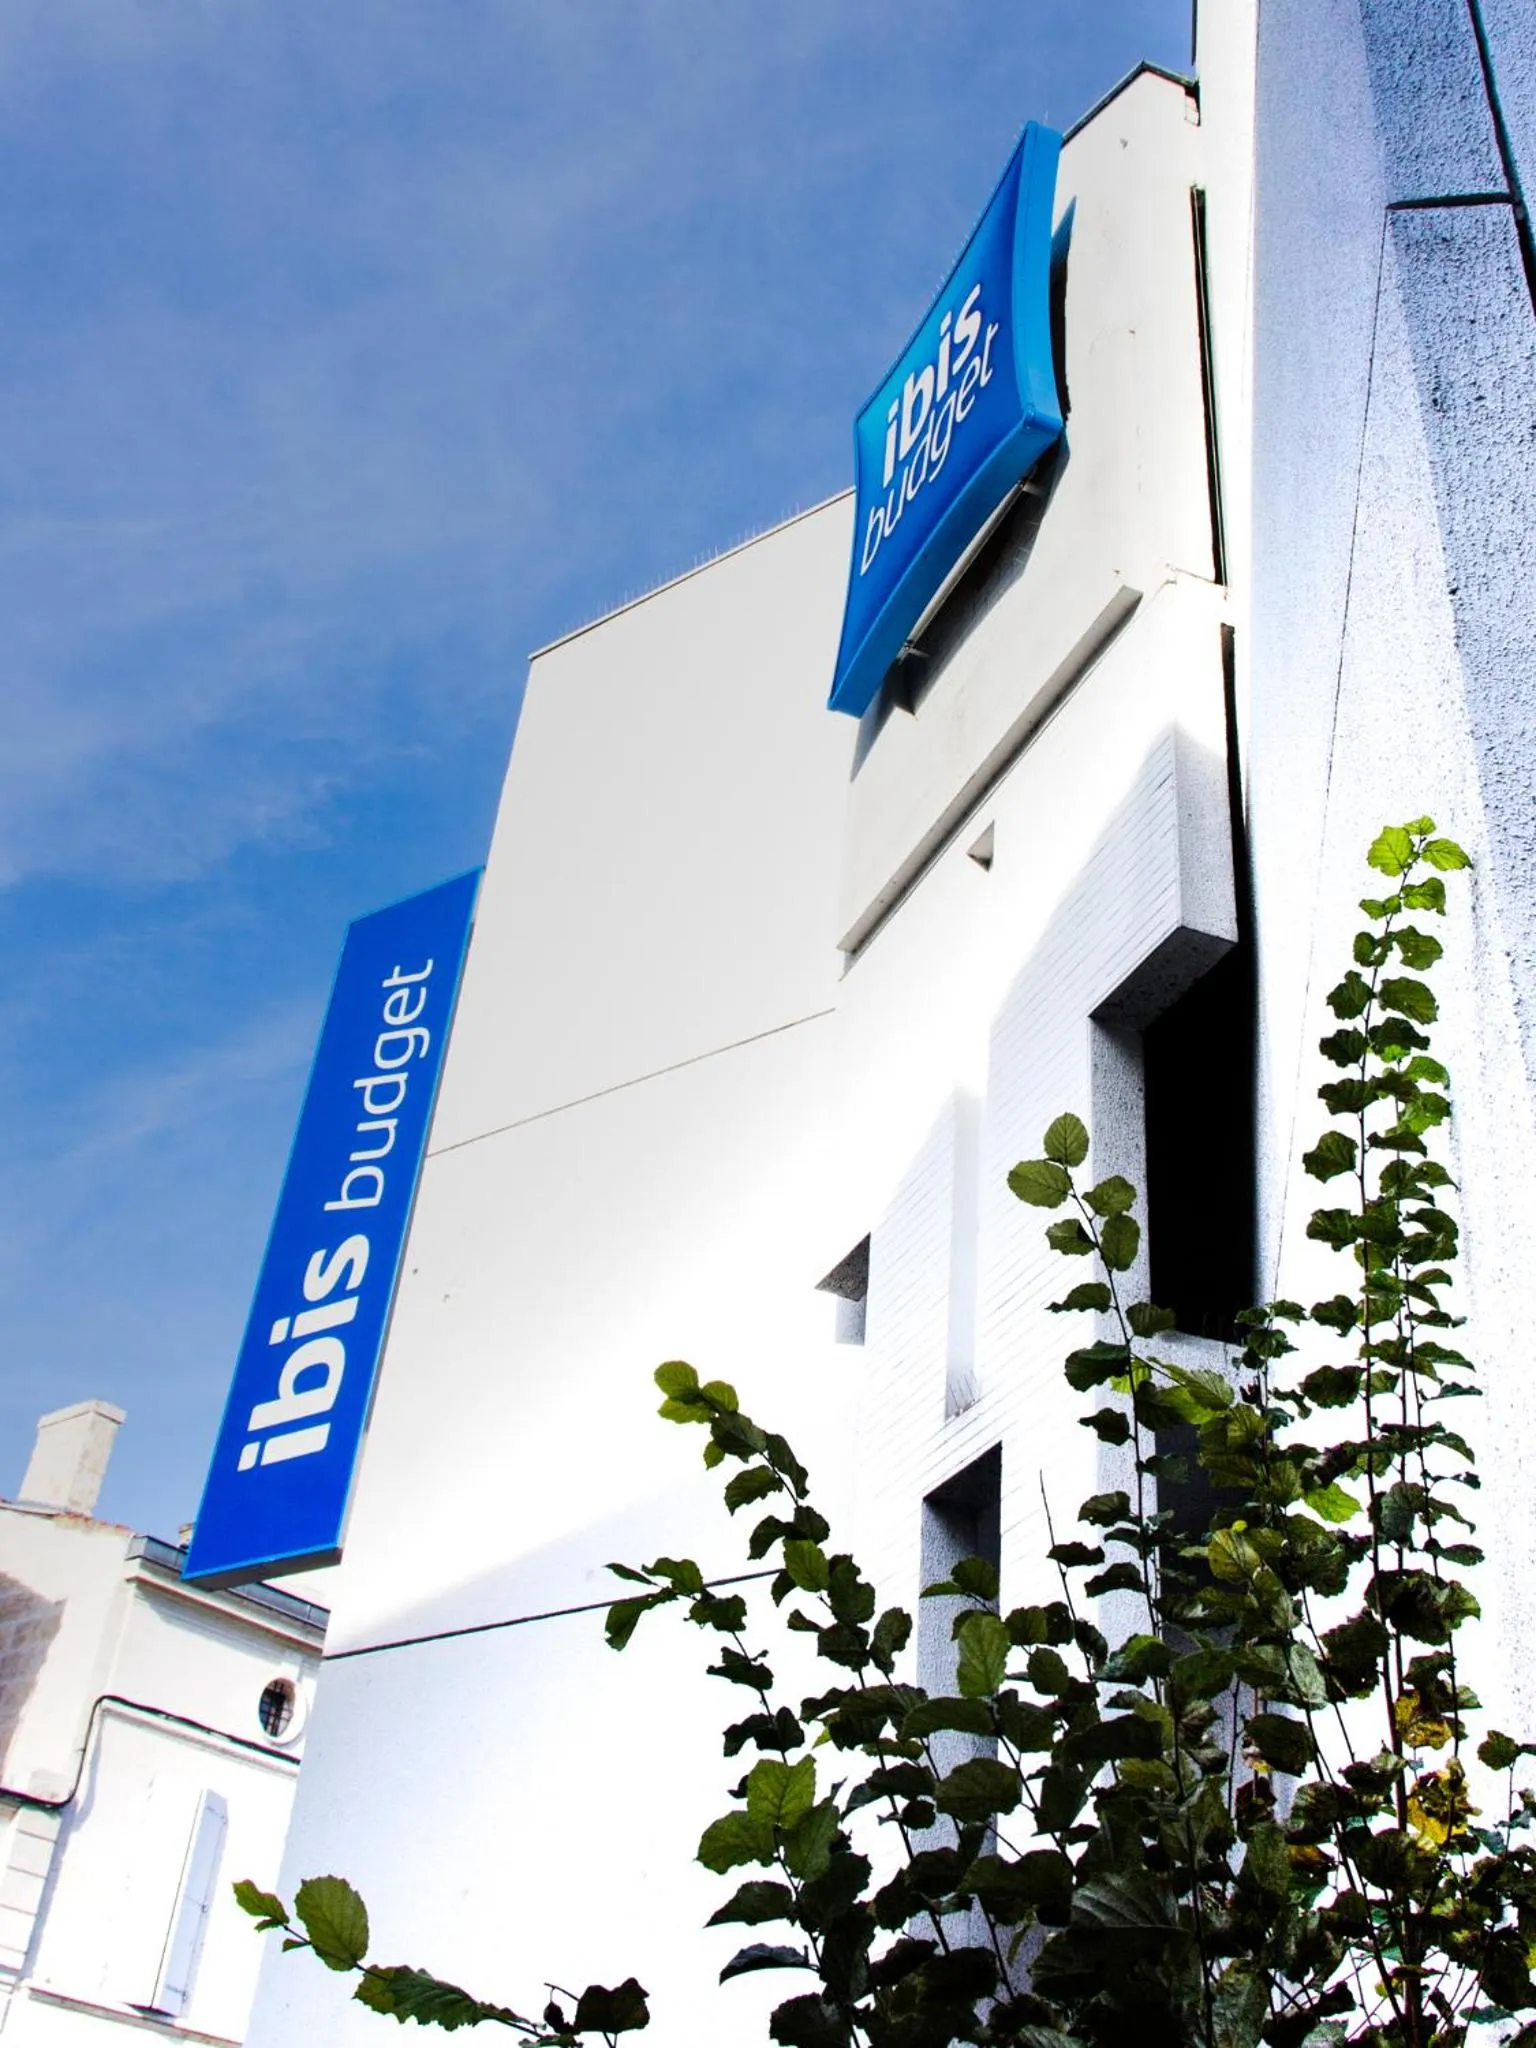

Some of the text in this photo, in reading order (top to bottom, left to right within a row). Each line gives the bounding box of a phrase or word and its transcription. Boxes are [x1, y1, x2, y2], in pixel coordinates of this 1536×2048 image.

[860, 322, 999, 576] budget
[883, 283, 981, 488] ibis
[237, 958, 433, 1471] ibis budget
